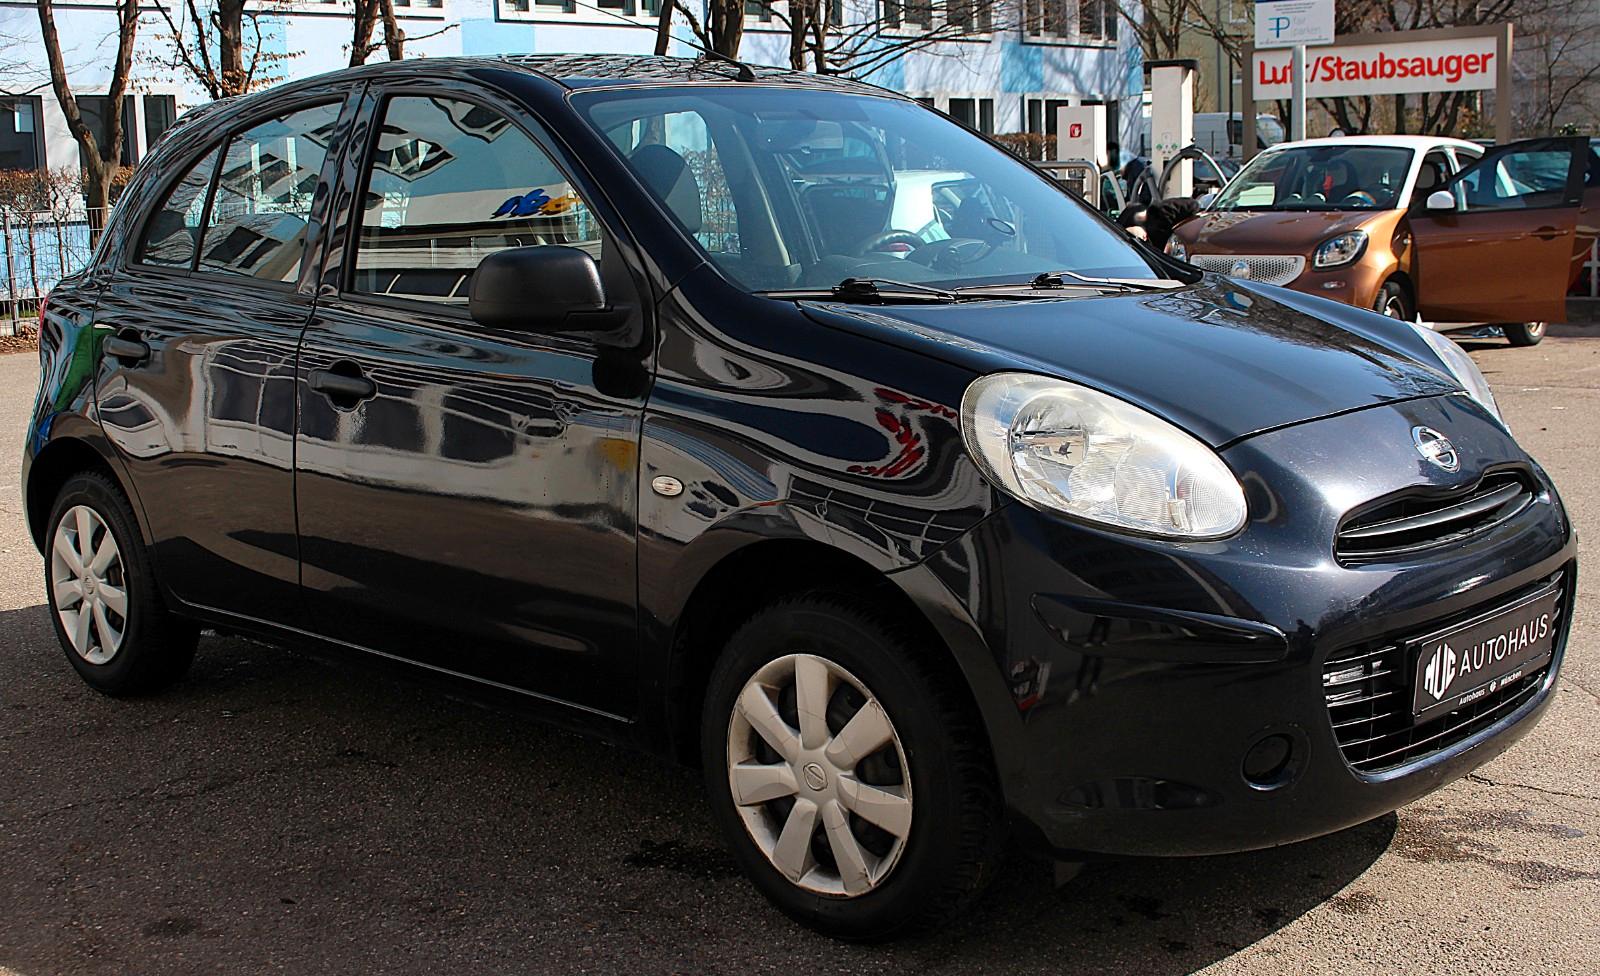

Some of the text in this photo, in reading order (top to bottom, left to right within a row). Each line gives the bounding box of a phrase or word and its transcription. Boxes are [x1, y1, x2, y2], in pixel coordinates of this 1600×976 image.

[1424, 614, 1549, 700] MUC AUTOHAUS
[1458, 689, 1486, 705] Autohaus
